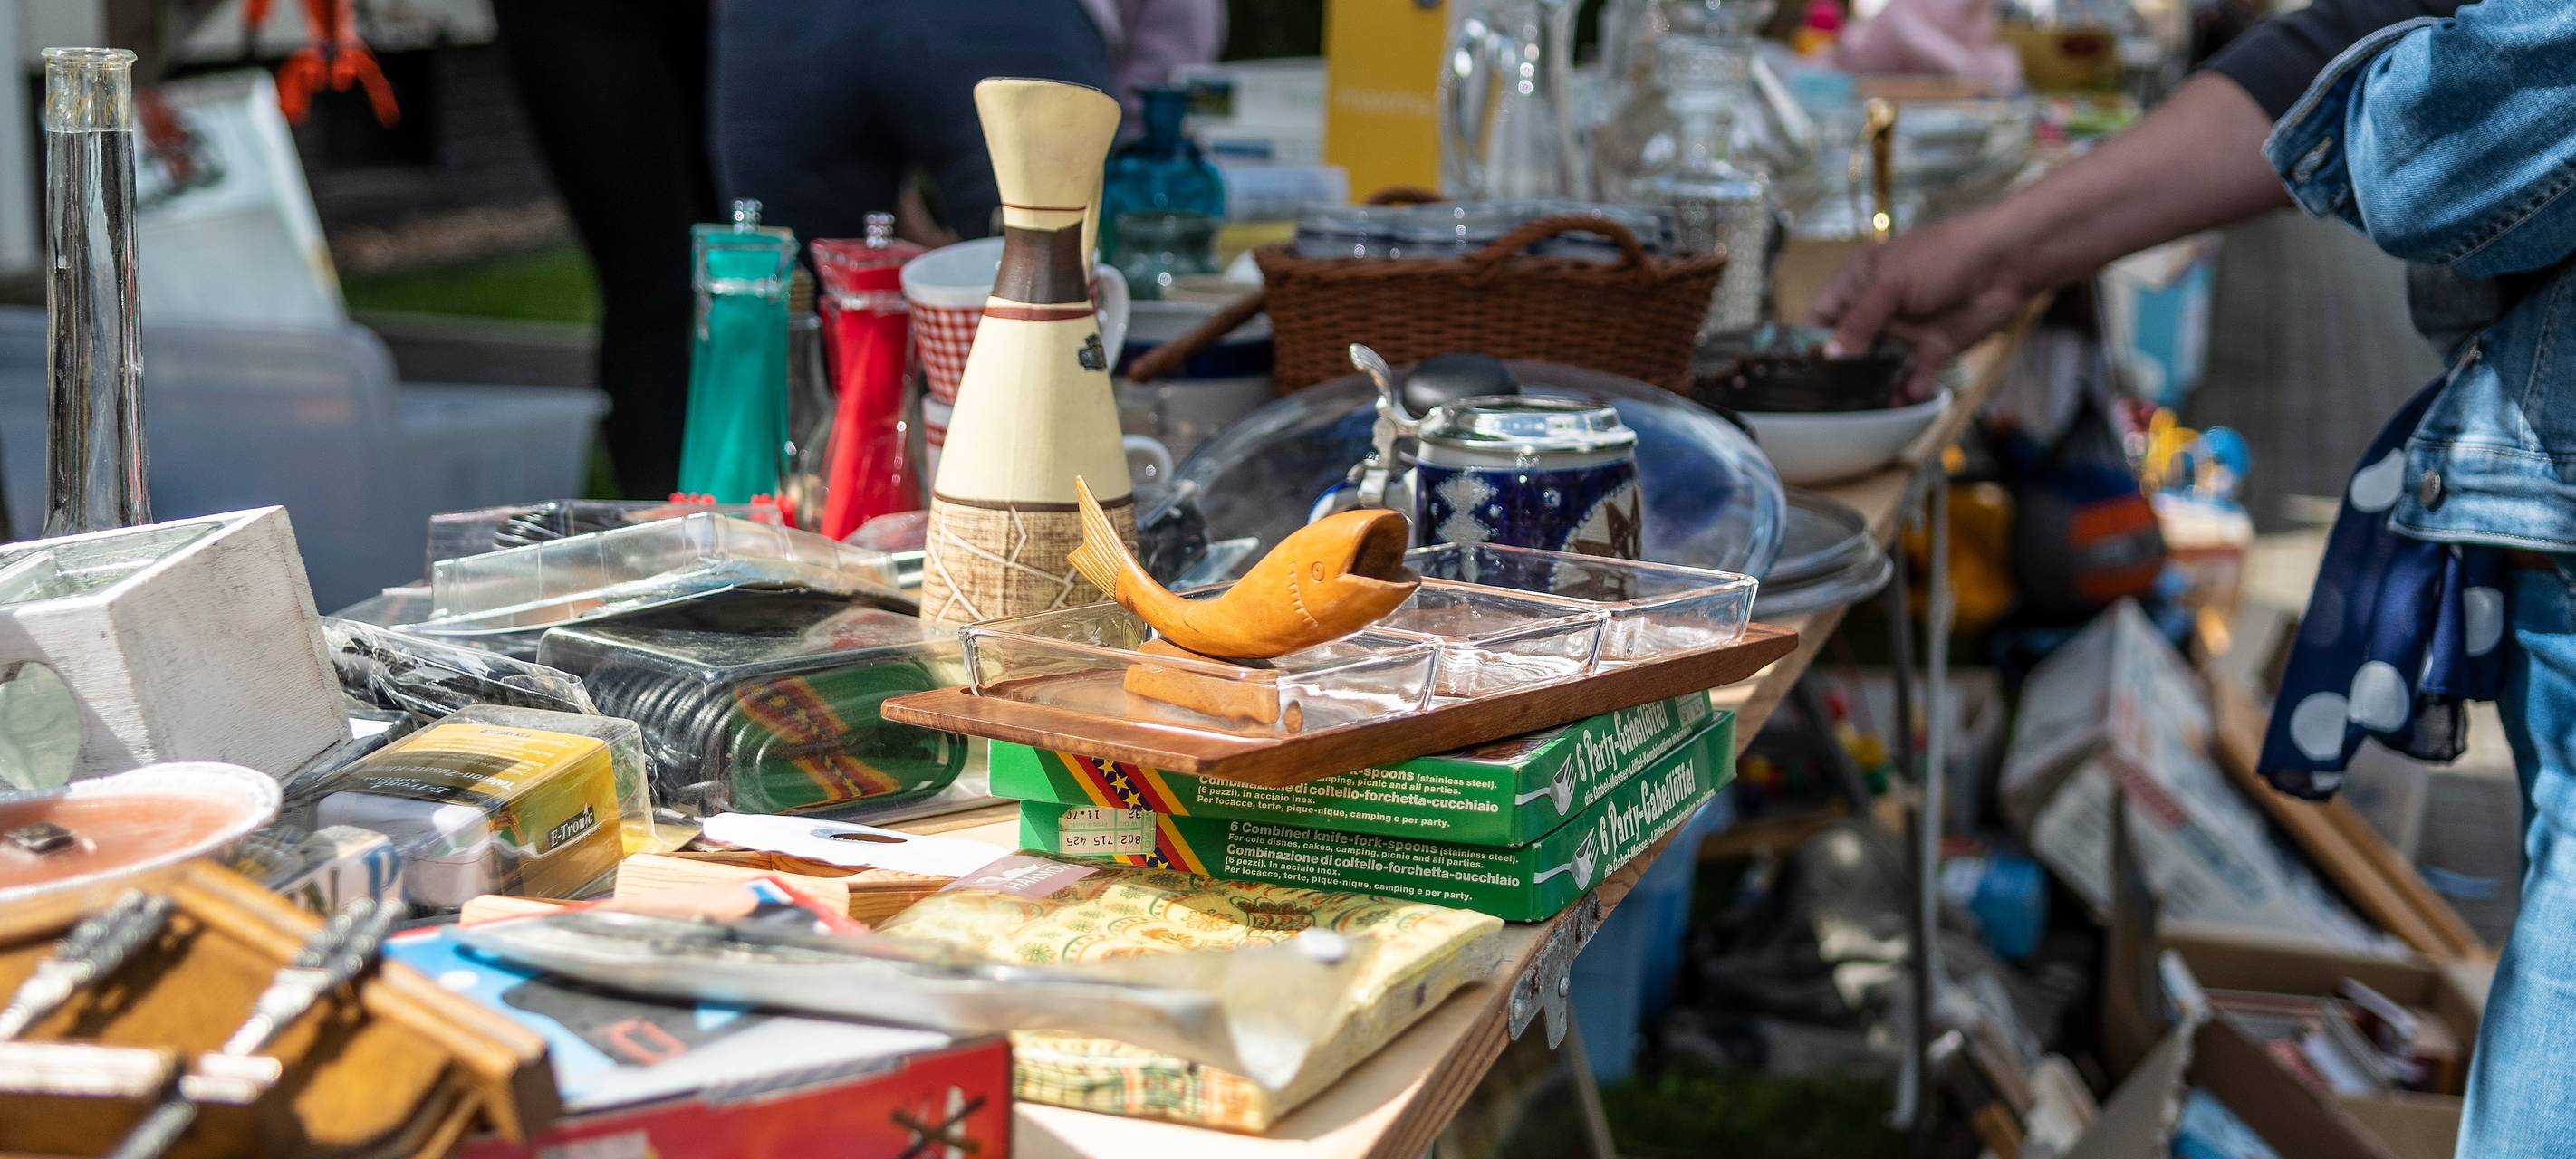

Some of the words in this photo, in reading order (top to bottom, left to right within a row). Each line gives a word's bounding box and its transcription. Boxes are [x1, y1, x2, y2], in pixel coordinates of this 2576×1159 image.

[1576, 742, 1587, 782] 6
[1583, 700, 1669, 785] Party-Gabellöffel
[1358, 779, 1387, 788] picnic
[1389, 781, 1408, 790] and
[1409, 783, 1422, 791] all
[1424, 785, 1461, 795] parties.
[1417, 774, 1465, 786] (stainless
[1466, 779, 1497, 790] steel).
[1198, 786, 1207, 795] (6
[1209, 787, 1240, 798] pezzi).
[1254, 792, 1290, 802] acciaio
[1292, 795, 1316, 804] inox.
[1294, 783, 1307, 794] di
[1309, 784, 1499, 813] coltello-forchetta-cucchiaio
[1585, 790, 1594, 805] die
[1600, 816, 1609, 855] 6
[1608, 757, 1696, 856] Party-Gabellöffel
[1197, 795, 1213, 803] Per
[1216, 797, 1255, 809] focacce,
[1258, 801, 1283, 811] torte,
[1286, 804, 1348, 818] pique-nique,
[1350, 811, 1391, 823] camping
[1402, 816, 1419, 825] per
[1421, 818, 1450, 829] party.
[551, 806, 593, 847] E-Tronic
[1067, 836, 1086, 846] 425
[1093, 835, 1113, 846] 715
[1121, 835, 1141, 845] 802
[1228, 833, 1243, 841] For
[1245, 836, 1265, 844] cold
[1267, 838, 1300, 848] dishes,
[1303, 842, 1333, 853] cakes,
[1336, 847, 1379, 857] camping,
[1381, 851, 1410, 860] picnic
[1413, 855, 1430, 863] and
[1433, 856, 1444, 864] all
[1447, 859, 1484, 869] parties.
[1230, 821, 1239, 831] 6
[1242, 822, 1310, 839] Combined
[1313, 830, 1437, 854] knife-fork-spoons
[1440, 847, 1486, 859] (stainless
[1488, 853, 1519, 864] steel).
[1226, 856, 1235, 865] (6
[1236, 857, 1266, 868] pezzi).
[1281, 863, 1314, 873] acciaio
[1317, 867, 1341, 876] inox.
[1227, 844, 1319, 864] Combinazione
[1320, 855, 1332, 866] di
[1334, 857, 1520, 886] coltello-forchetta-cucchiaio
[1605, 861, 1613, 878] die
[1225, 866, 1239, 874] Per
[1242, 867, 1282, 879] focacce,
[1283, 872, 1309, 883] torte,
[1312, 876, 1372, 890] pique-nique,
[1374, 884, 1415, 895] camping
[1444, 891, 1473, 901] party.
